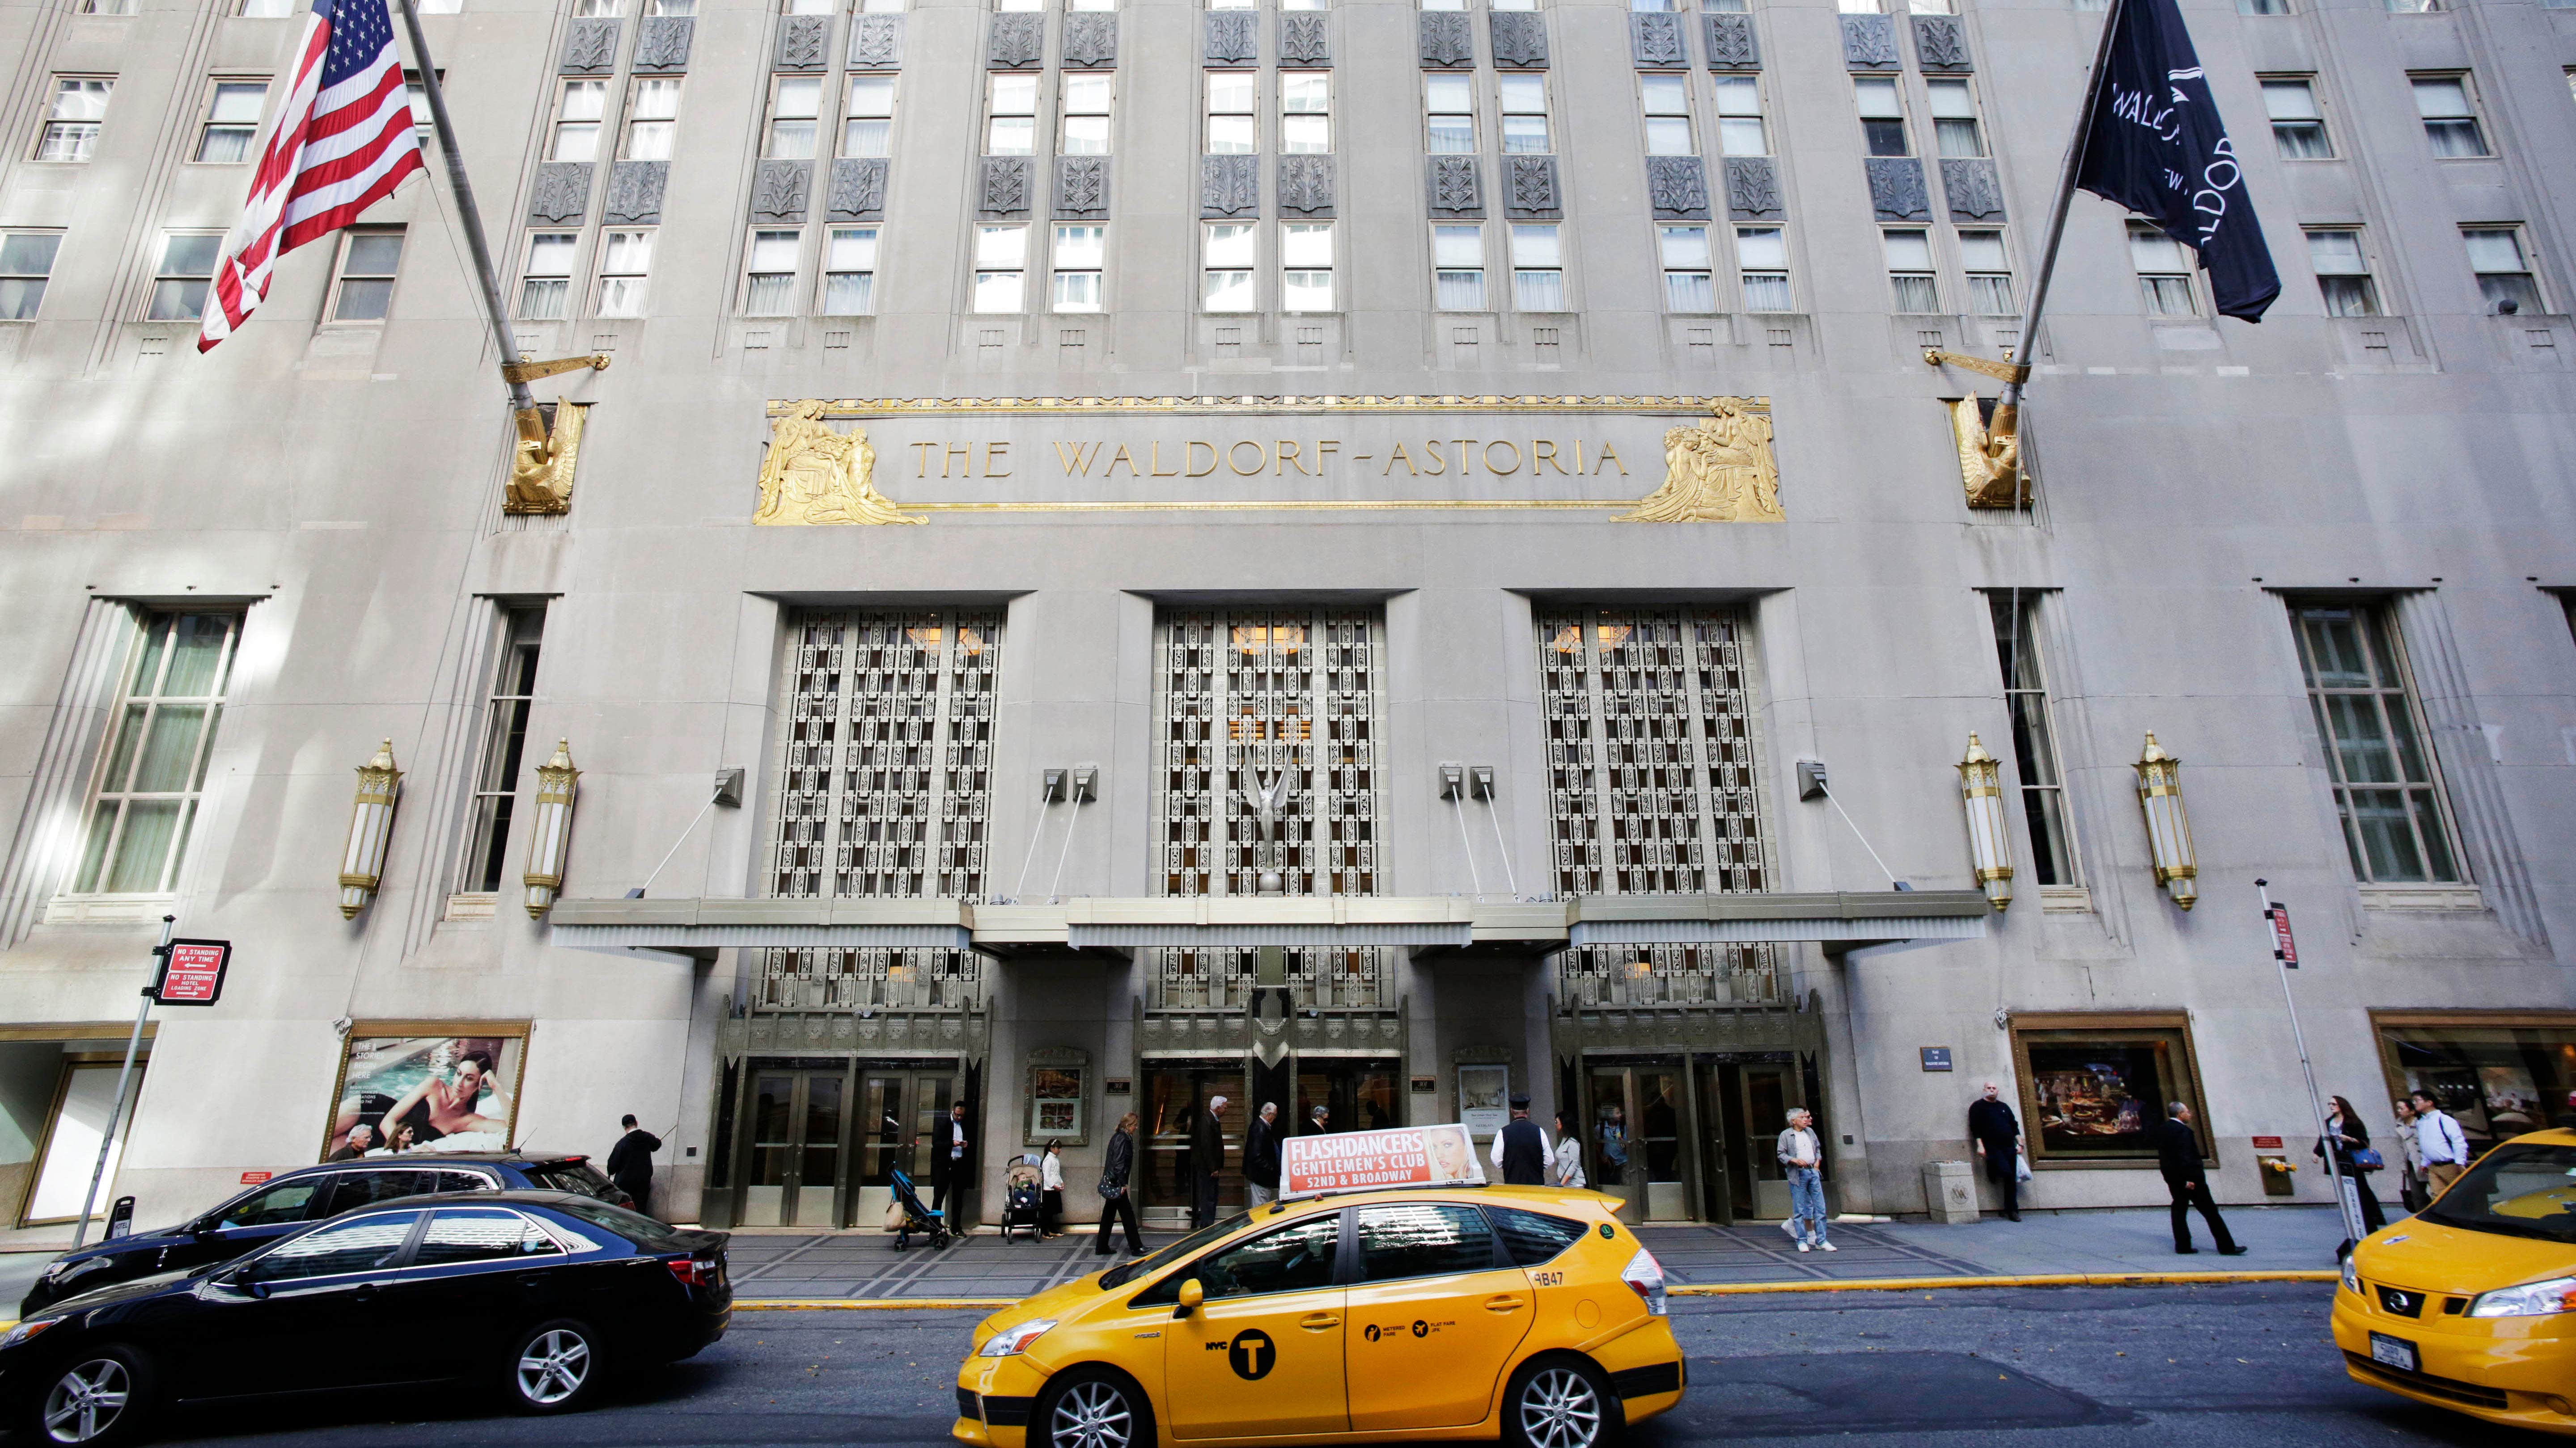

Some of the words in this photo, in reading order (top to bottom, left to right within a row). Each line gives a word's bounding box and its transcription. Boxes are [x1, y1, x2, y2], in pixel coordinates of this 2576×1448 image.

[909, 442, 1013, 478] THE
[358, 1042, 371, 1050] THE
[1291, 1131, 1424, 1161] FLASHDANCERS
[1292, 1156, 1386, 1176] GENTLEMEN'S
[1392, 1153, 1426, 1168] CLUB
[1307, 1174, 1336, 1188] 52ND
[1340, 1172, 1348, 1185] &
[1352, 1169, 1412, 1185] BROADWAY
[1534, 1272, 1563, 1286] 9B47
[1206, 1342, 1228, 1351] NYC
[1239, 1339, 1265, 1374] T
